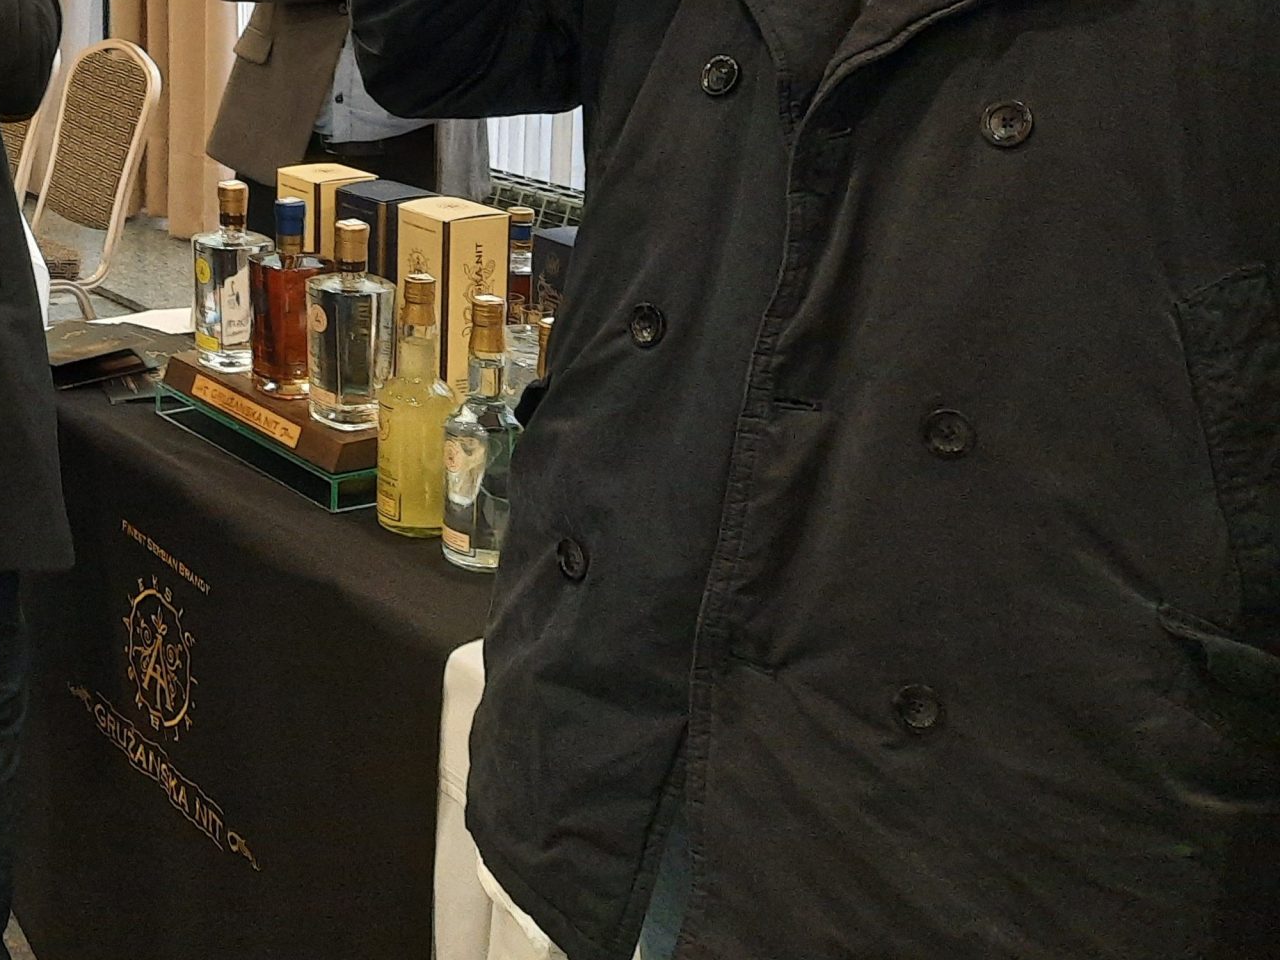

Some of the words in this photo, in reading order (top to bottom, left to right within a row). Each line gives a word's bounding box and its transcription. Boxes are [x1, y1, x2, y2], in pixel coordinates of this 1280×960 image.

[146, 537, 179, 573] SERBIAN
[178, 561, 212, 596] BRANDY
[194, 796, 225, 841] NIT
